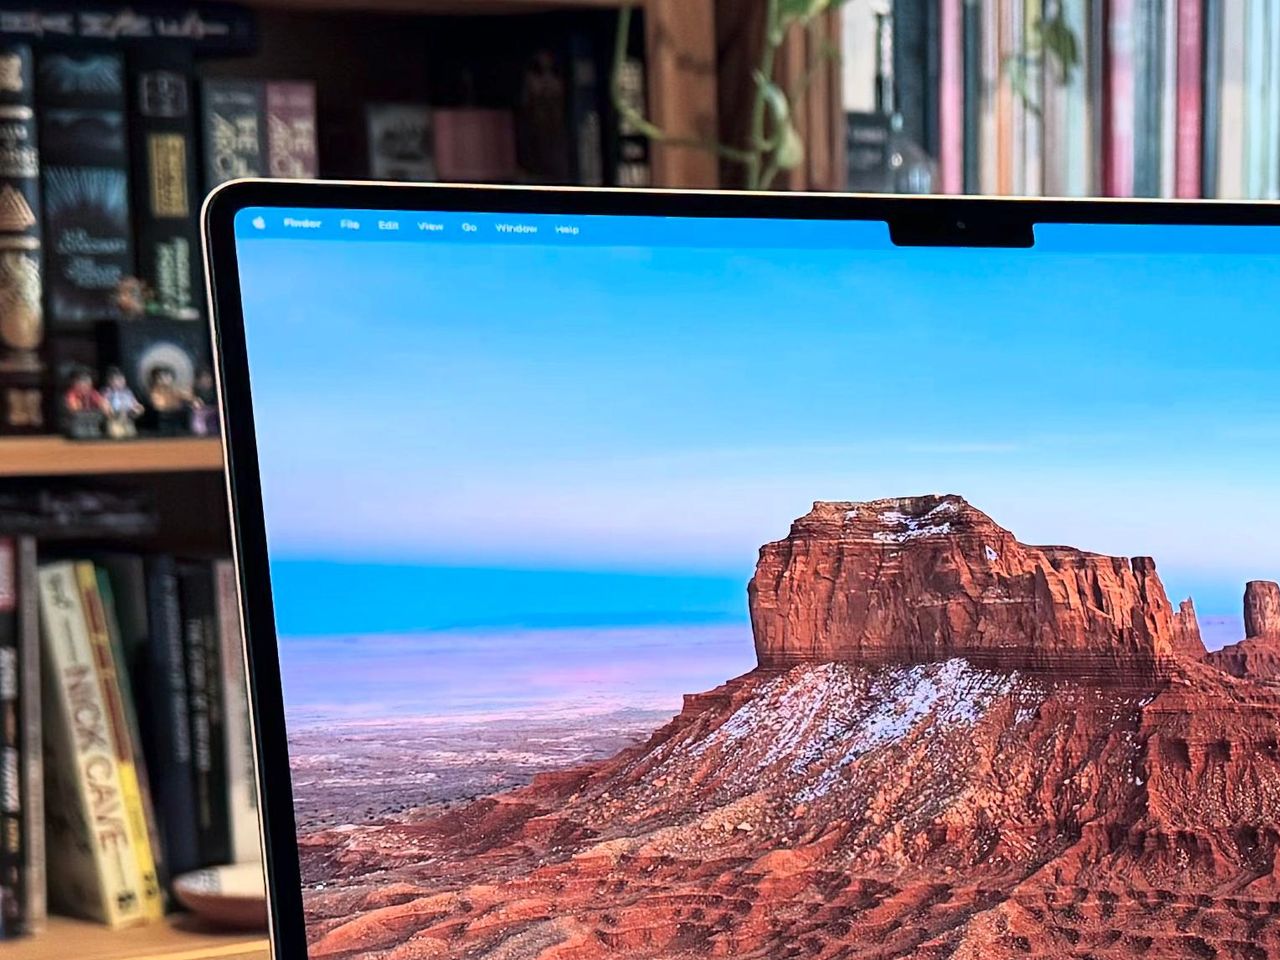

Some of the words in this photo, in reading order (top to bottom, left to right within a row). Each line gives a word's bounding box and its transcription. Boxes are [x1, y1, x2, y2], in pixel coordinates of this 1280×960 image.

[340, 219, 360, 230] File
[378, 220, 399, 230] Edit
[417, 222, 444, 231] View
[496, 223, 538, 233] Window
[63, 664, 107, 753] NICK
[85, 756, 128, 850] CAVE
